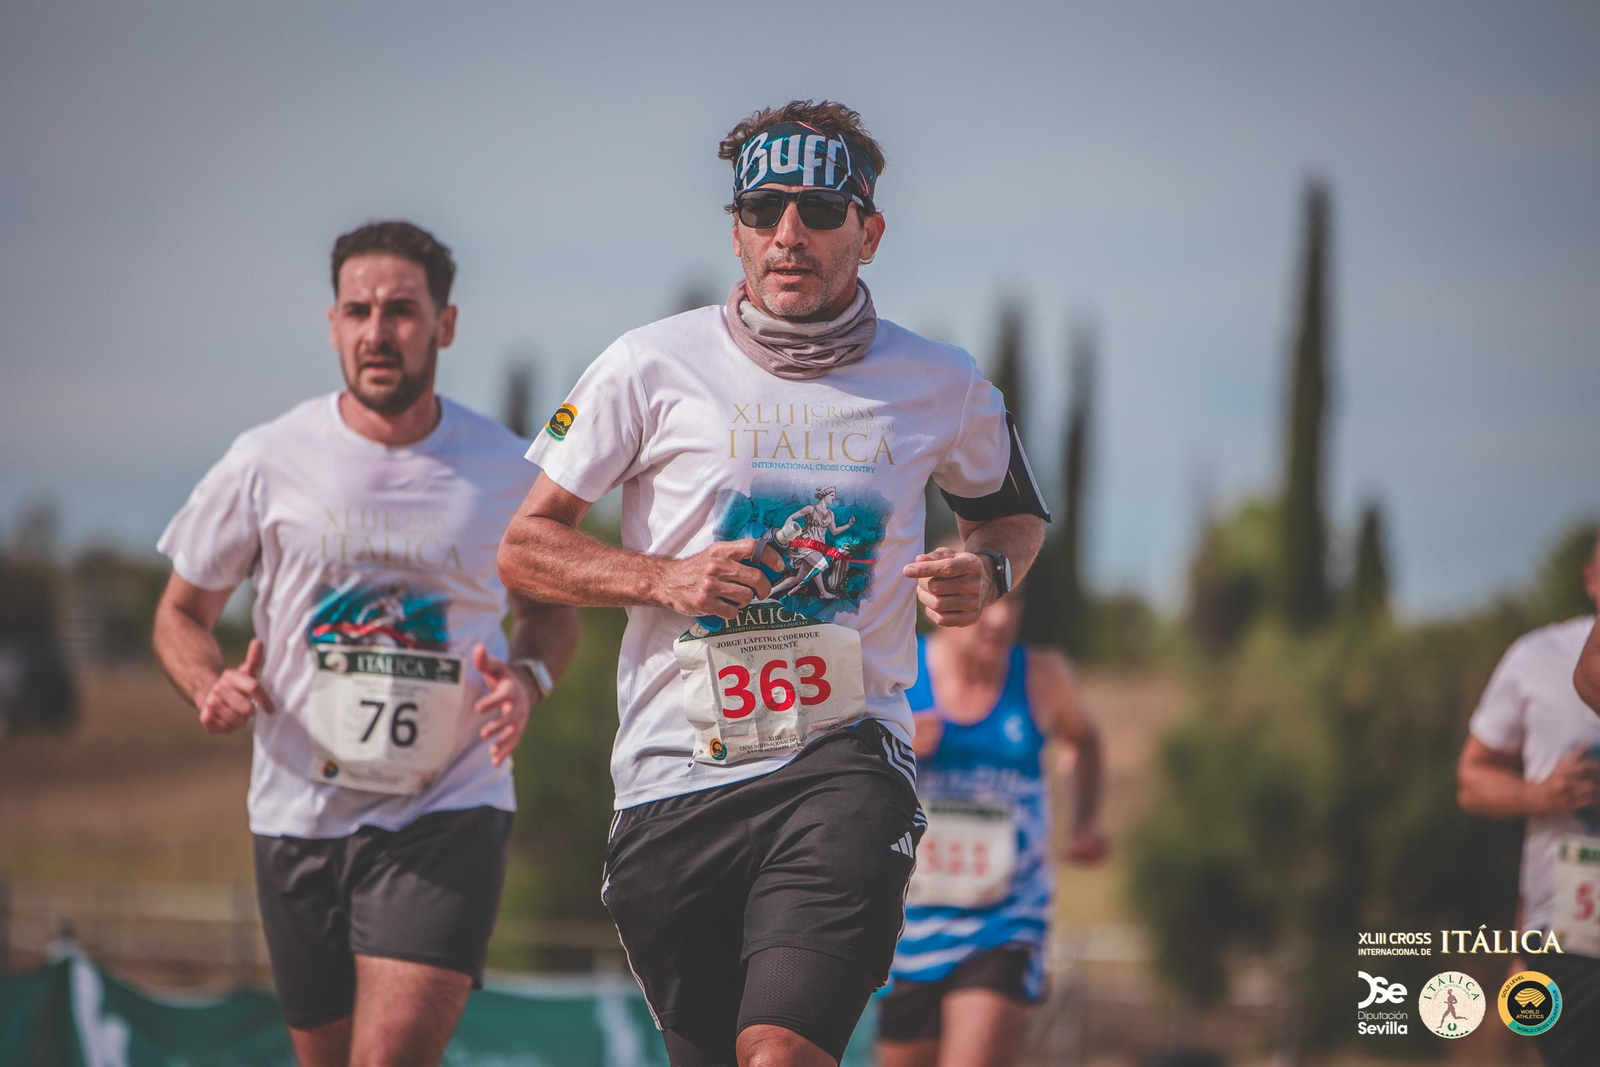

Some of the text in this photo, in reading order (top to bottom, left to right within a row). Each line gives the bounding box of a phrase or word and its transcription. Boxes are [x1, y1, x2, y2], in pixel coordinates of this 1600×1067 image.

[731, 403, 811, 425] XLIII
[810, 405, 875, 421] CROSS
[811, 419, 897, 433] INTERNACIONAL
[728, 423, 897, 466] ITÁLICA
[751, 461, 876, 474] INTERNATIONAL CROSS COUNTRY
[716, 631, 820, 649] JORGE LAPETRA CODERQUE
[740, 641, 799, 654] INDEPENDIENTE
[718, 655, 832, 719] 363
[359, 700, 418, 748] 76
